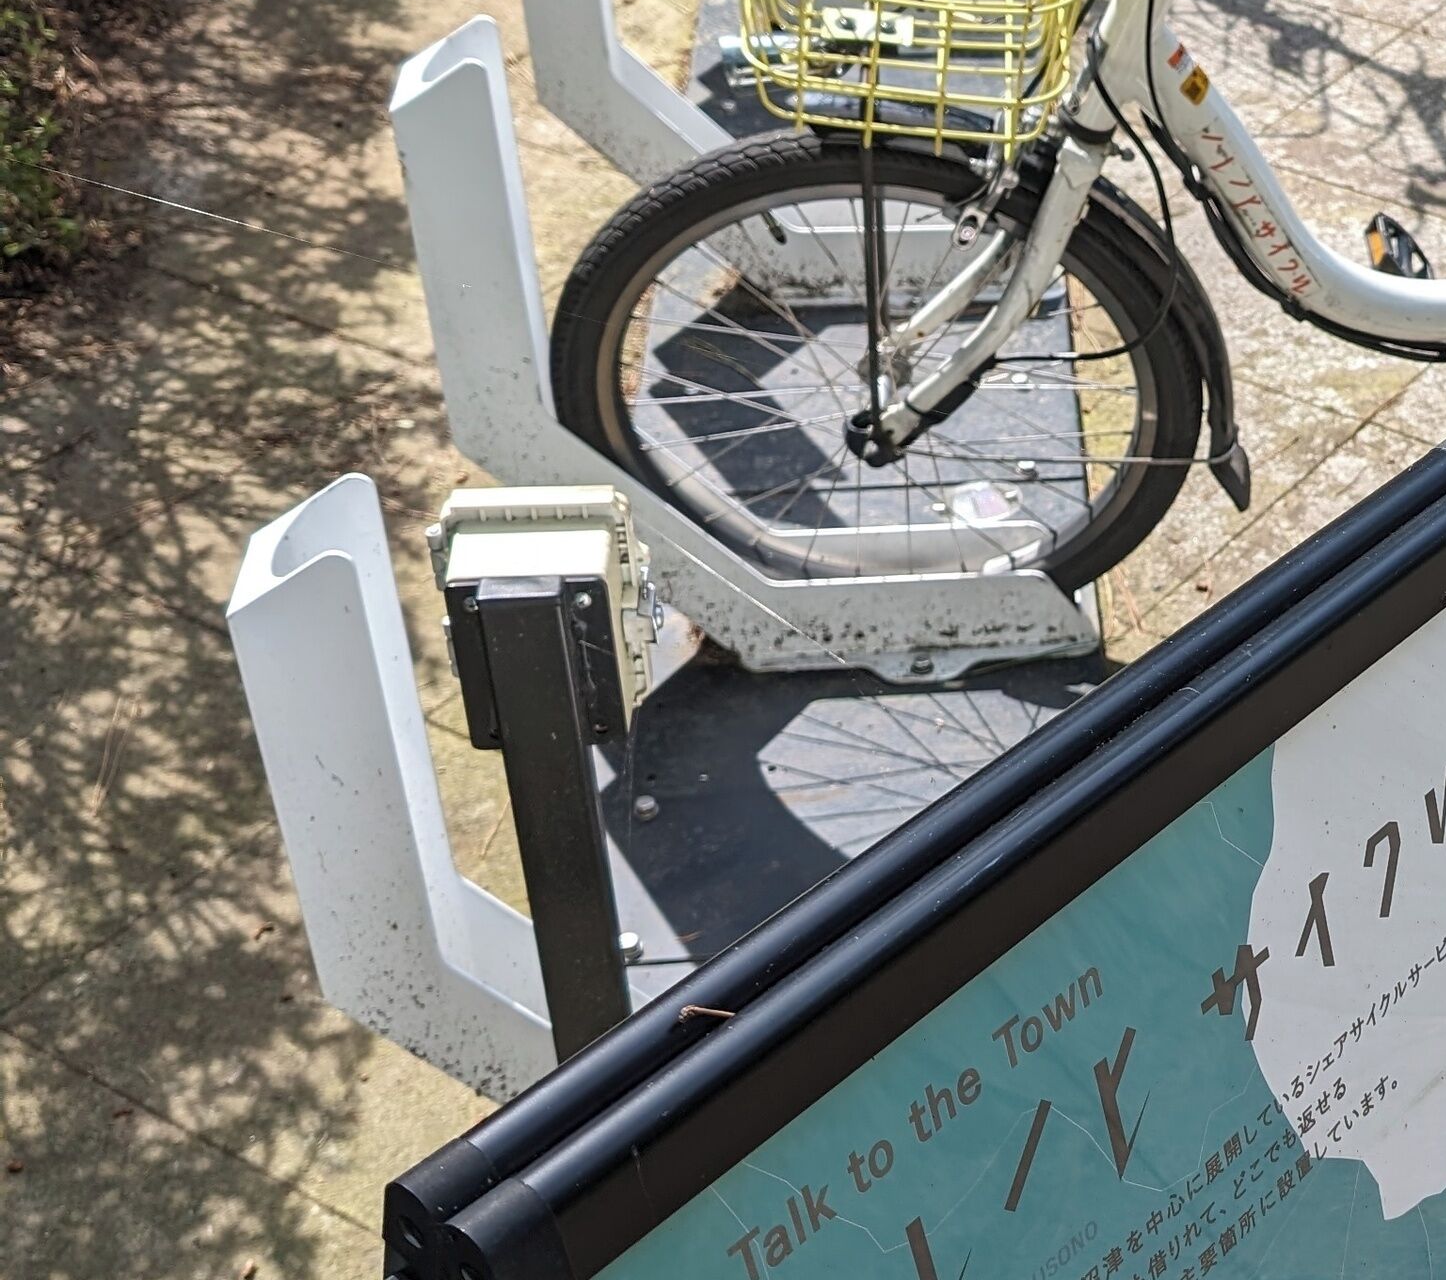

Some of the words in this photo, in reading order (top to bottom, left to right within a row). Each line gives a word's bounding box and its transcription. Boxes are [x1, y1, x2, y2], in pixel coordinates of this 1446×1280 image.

[846, 1139, 895, 1194] to
[908, 1066, 982, 1143] the
[991, 965, 1104, 1069] Town
